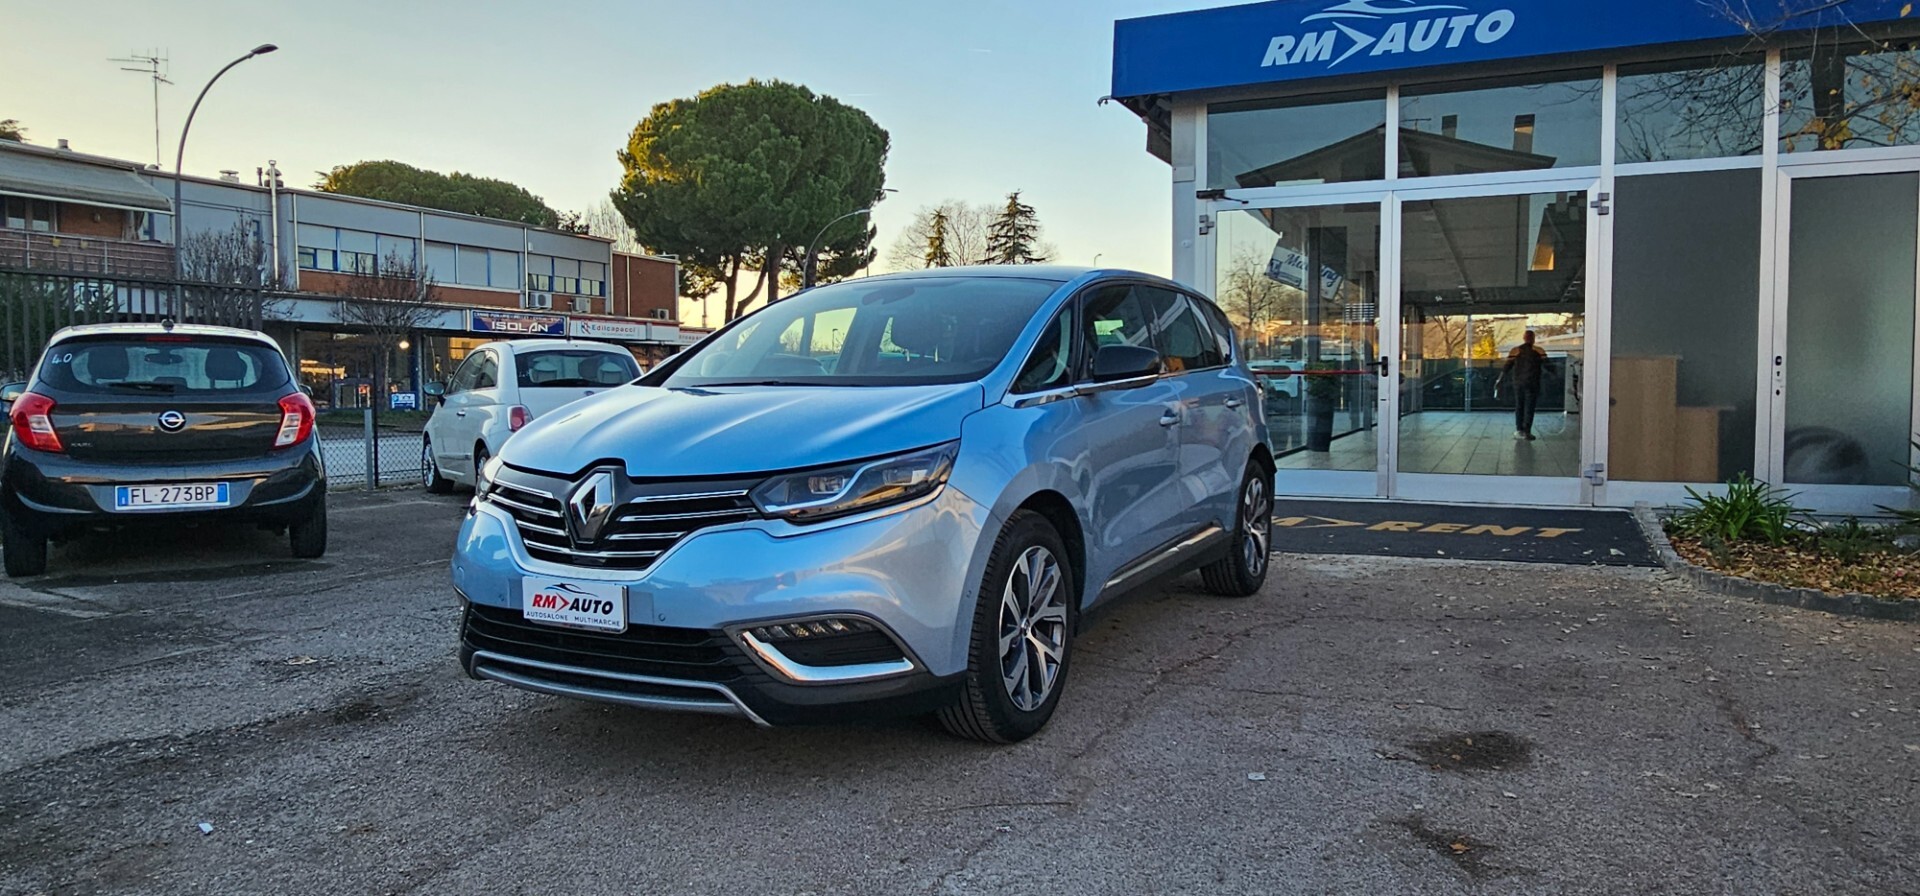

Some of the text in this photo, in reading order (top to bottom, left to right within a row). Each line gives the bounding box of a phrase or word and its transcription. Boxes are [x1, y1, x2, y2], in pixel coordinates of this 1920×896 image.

[1369, 9, 1515, 56] AUTO
[491, 320, 549, 333] ISOLAN
[591, 323, 636, 334] Edilcapacci
[1366, 520, 1584, 538] RENT
[569, 598, 613, 615] AUTO
[526, 611, 568, 621] AUTOSALONE
[574, 616, 620, 627] MULTIMARCHE
